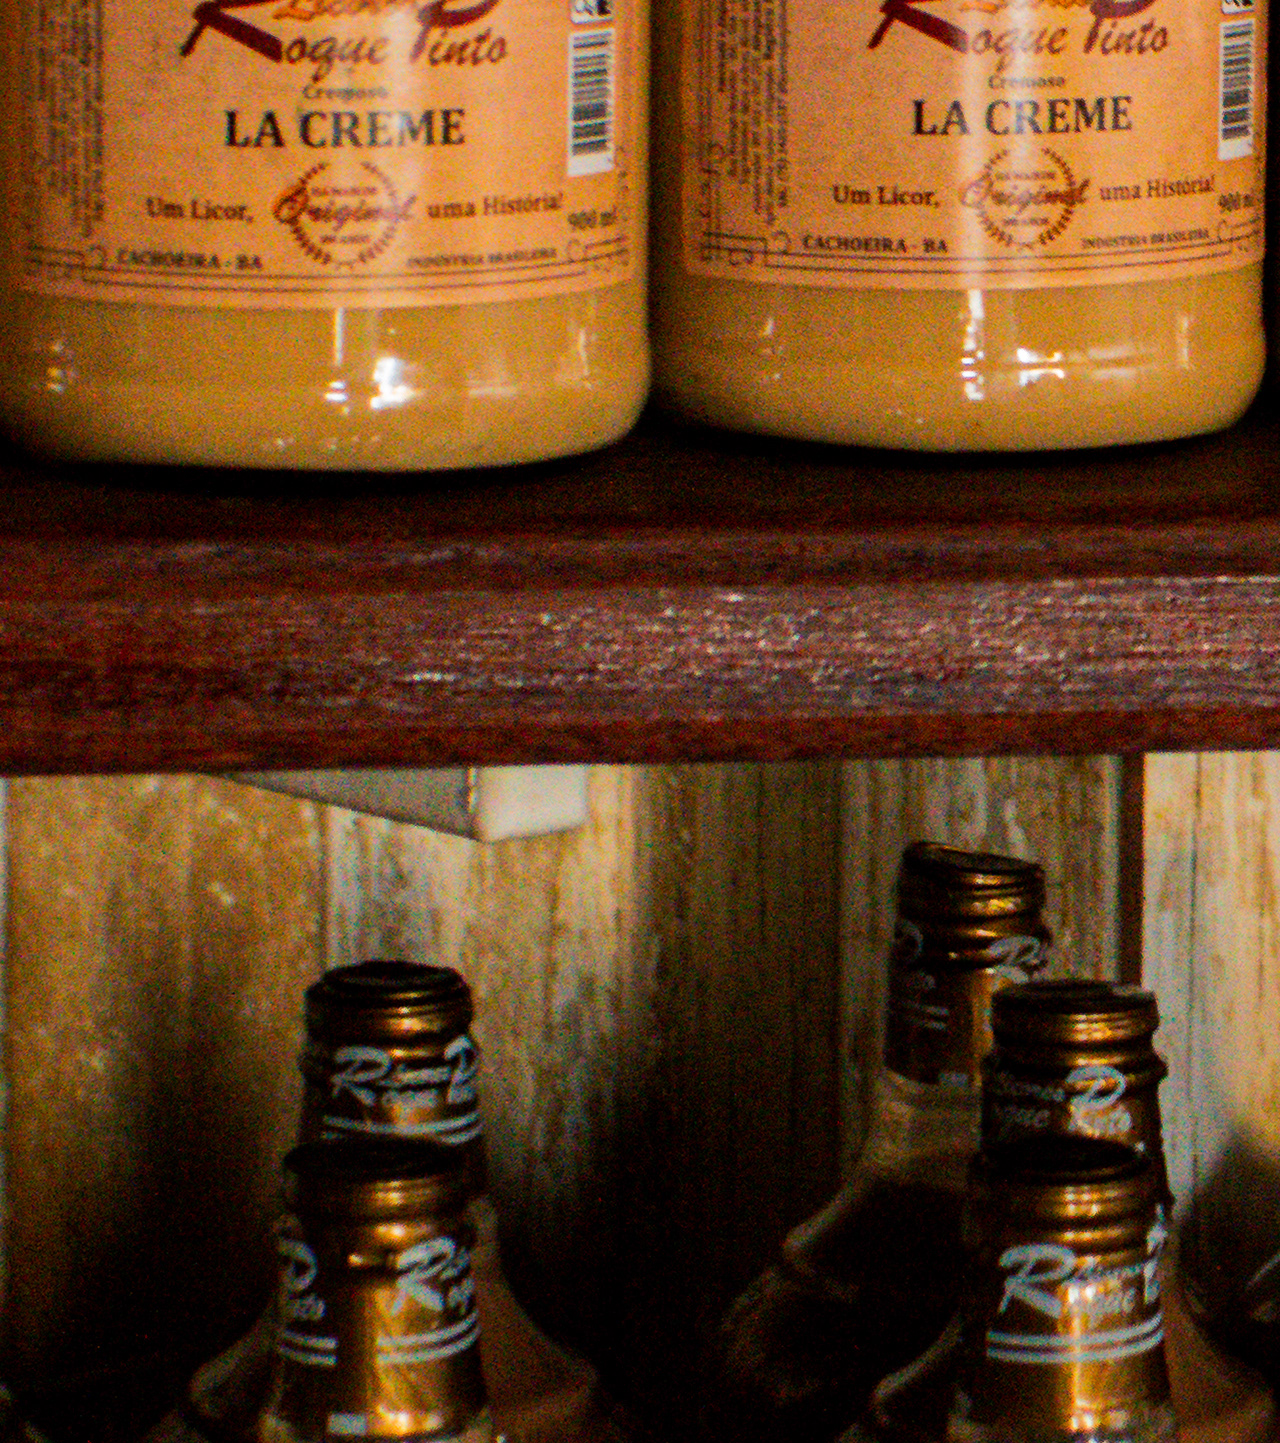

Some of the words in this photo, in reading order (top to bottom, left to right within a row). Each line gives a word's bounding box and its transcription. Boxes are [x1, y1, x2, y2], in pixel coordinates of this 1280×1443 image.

[224, 109, 285, 148] LA
[300, 108, 465, 148] CREME
[912, 99, 969, 136] LA
[984, 96, 1133, 136] CREME
[145, 197, 184, 219] Um
[191, 198, 253, 223] Licor,
[427, 200, 476, 219] uma
[483, 192, 564, 215] História!
[832, 185, 871, 204] Um
[878, 185, 939, 208] Licor,
[1100, 184, 1140, 201] uma
[1147, 175, 1216, 198] História!
[118, 249, 219, 269] CACHOEIRA
[237, 254, 261, 270] BA
[803, 234, 906, 252] CACHOEIRA
[923, 237, 948, 253] BA
